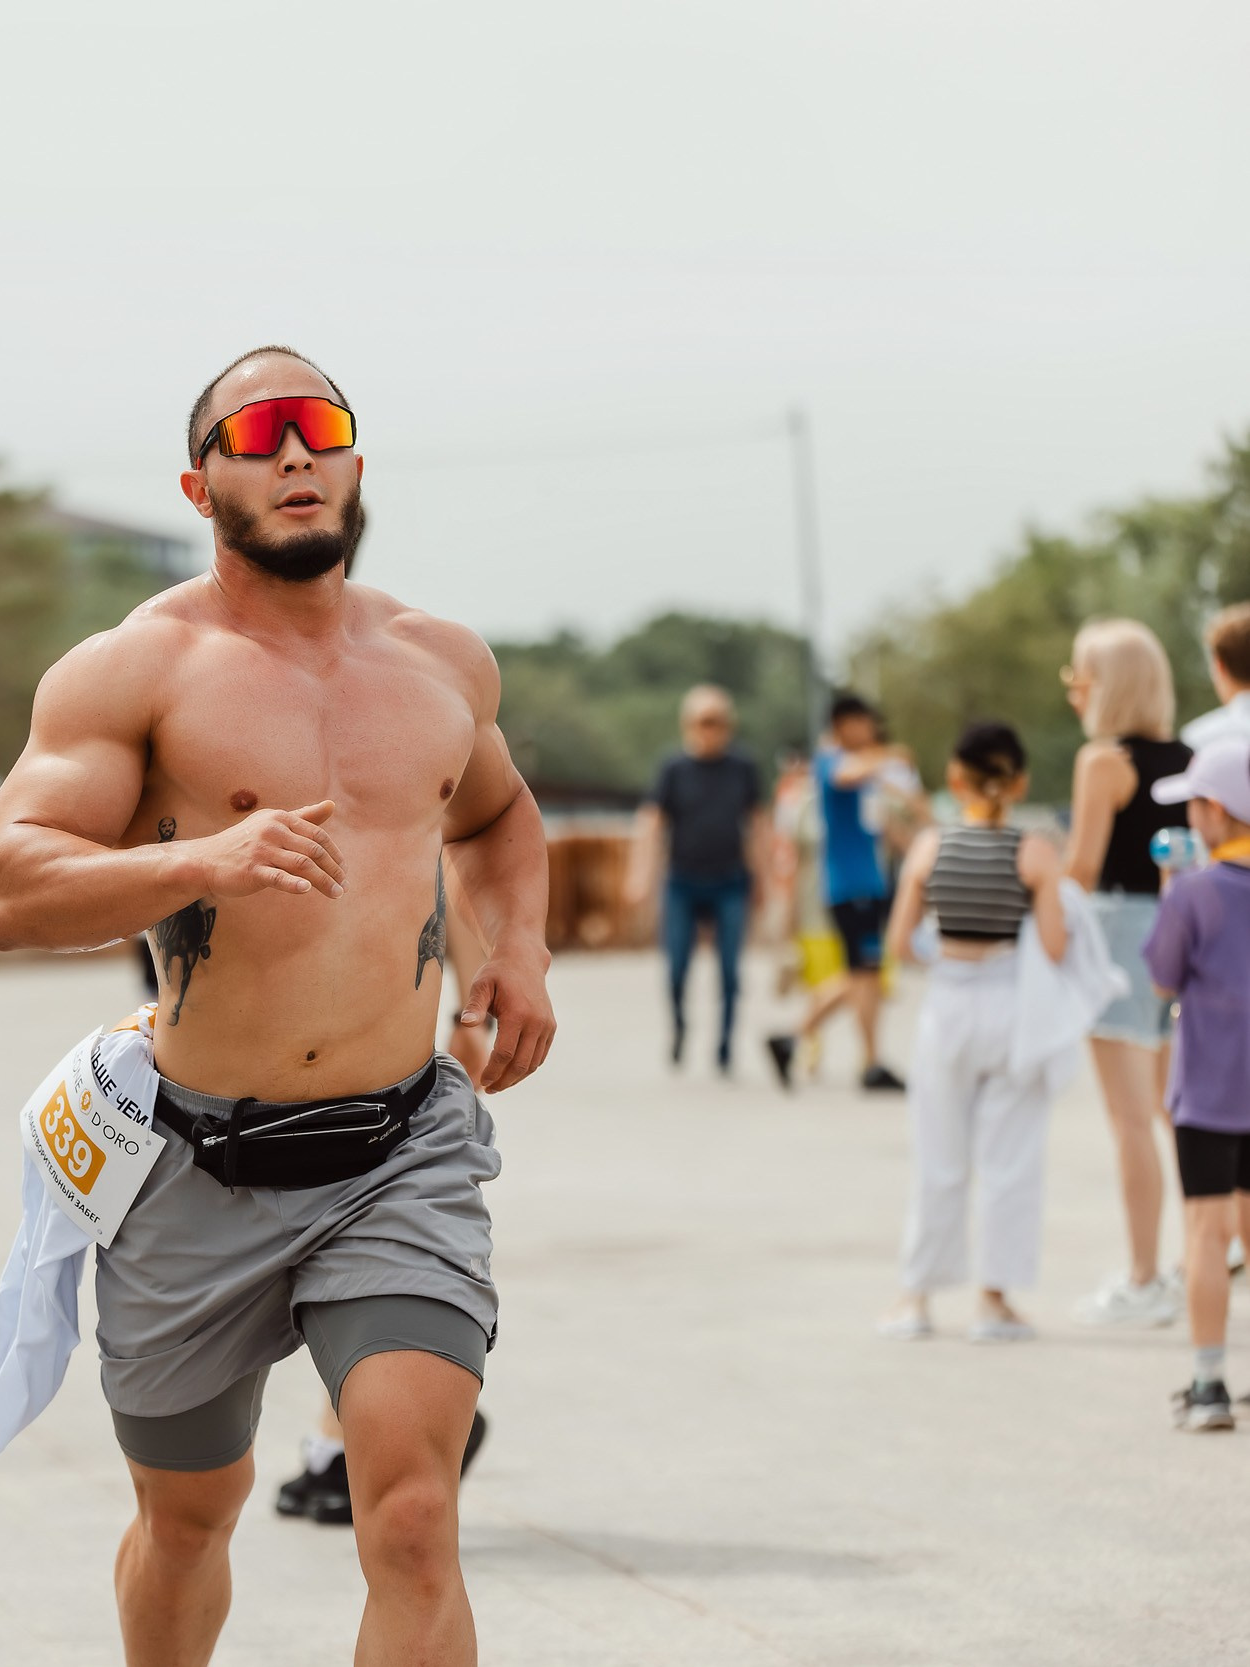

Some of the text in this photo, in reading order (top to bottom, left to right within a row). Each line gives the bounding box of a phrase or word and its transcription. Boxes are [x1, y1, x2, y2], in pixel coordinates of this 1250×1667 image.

[116, 1092, 149, 1126] ЧЕМ
[45, 1095, 93, 1178] 339
[91, 1111, 140, 1155] D'ORO
[74, 1199, 101, 1223] ЗАБЕГ
